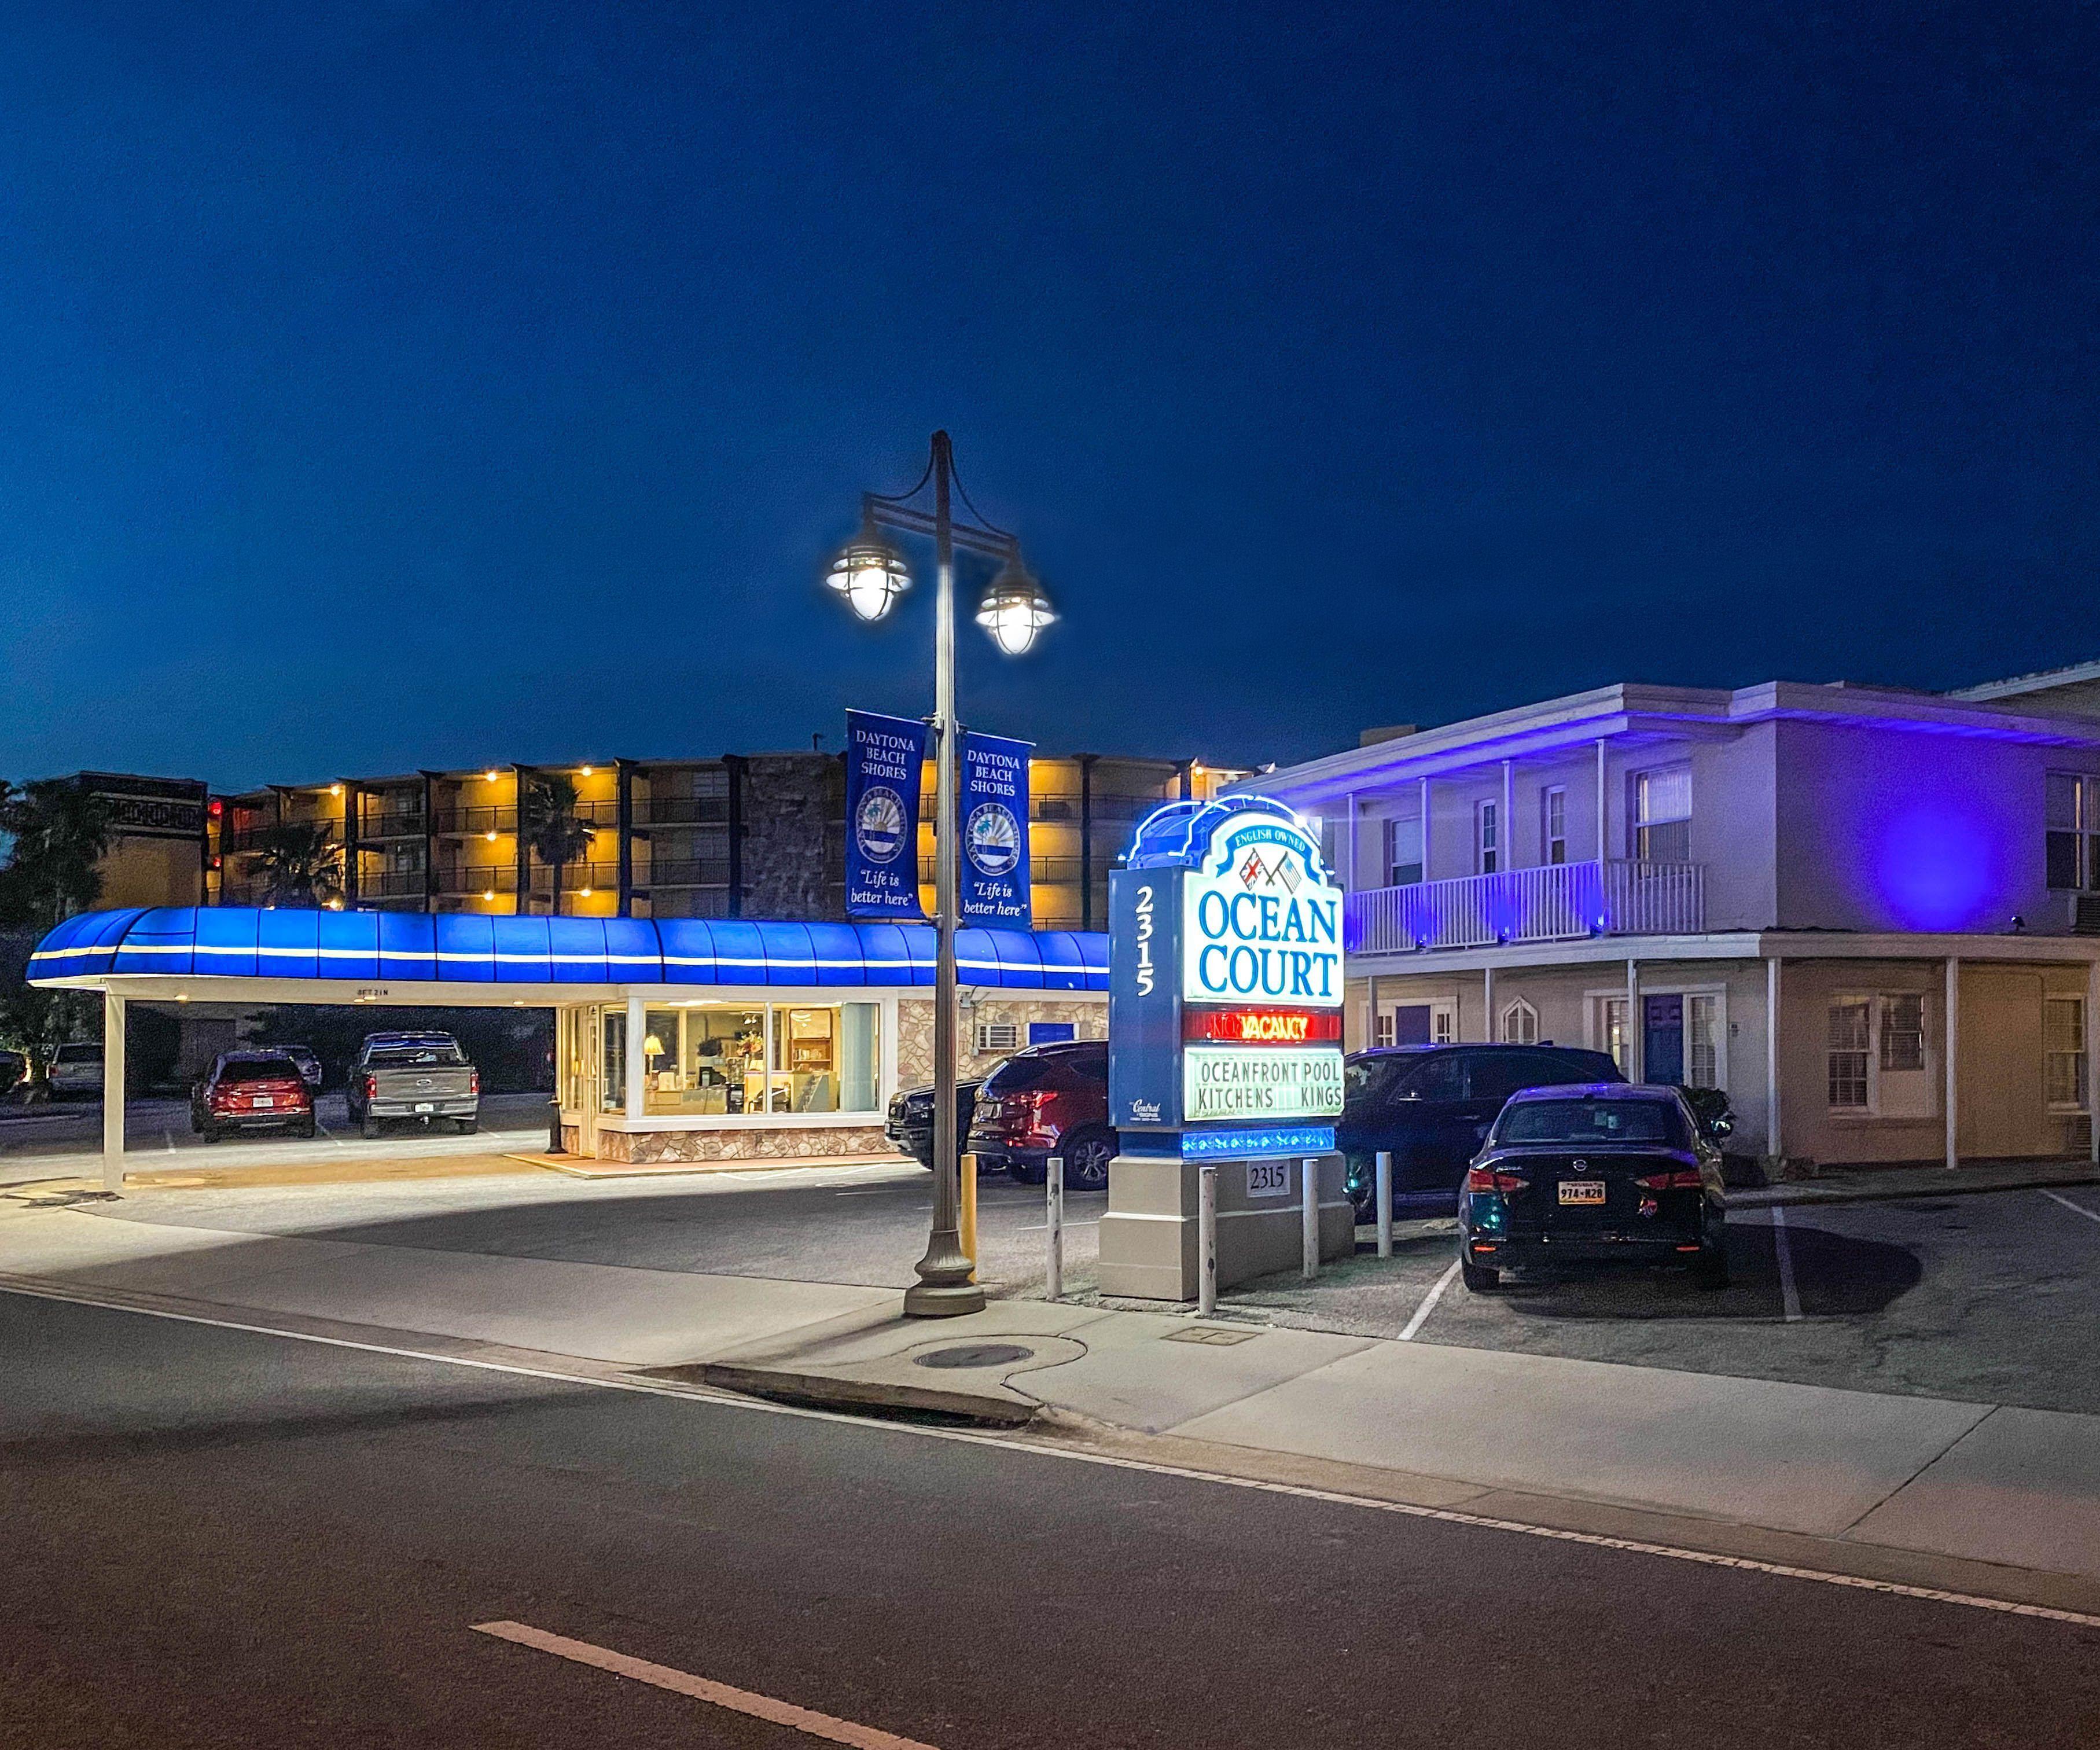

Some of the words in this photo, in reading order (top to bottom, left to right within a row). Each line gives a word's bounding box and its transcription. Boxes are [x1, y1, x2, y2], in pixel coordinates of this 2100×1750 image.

[856, 730, 915, 751] DAYTONA
[866, 747, 906, 764] BEACH
[968, 749, 1020, 770] DAYTONA
[861, 762, 907, 780] SHORES
[976, 765, 1013, 782] BEACH
[970, 780, 1015, 797] SHORES
[1235, 828, 1272, 847] ENGLISH
[1274, 830, 1306, 852] OWNED
[889, 873, 899, 887] is
[851, 887, 882, 903] better
[1003, 884, 1012, 898] is
[963, 899, 995, 914] better
[1198, 890, 1337, 944] OCEAN
[1135, 885, 1154, 997] 2315
[1198, 944, 1338, 997] COURT
[1241, 1015, 1308, 1040] VACANCY
[1201, 1061, 1298, 1083] OCEANFRONT
[1304, 1061, 1340, 1082] POOL
[1133, 1098, 1161, 1113] Central
[1198, 1087, 1274, 1109] KITCHENS
[1301, 1086, 1342, 1106] KINGS
[1250, 1166, 1285, 1190] 2315
